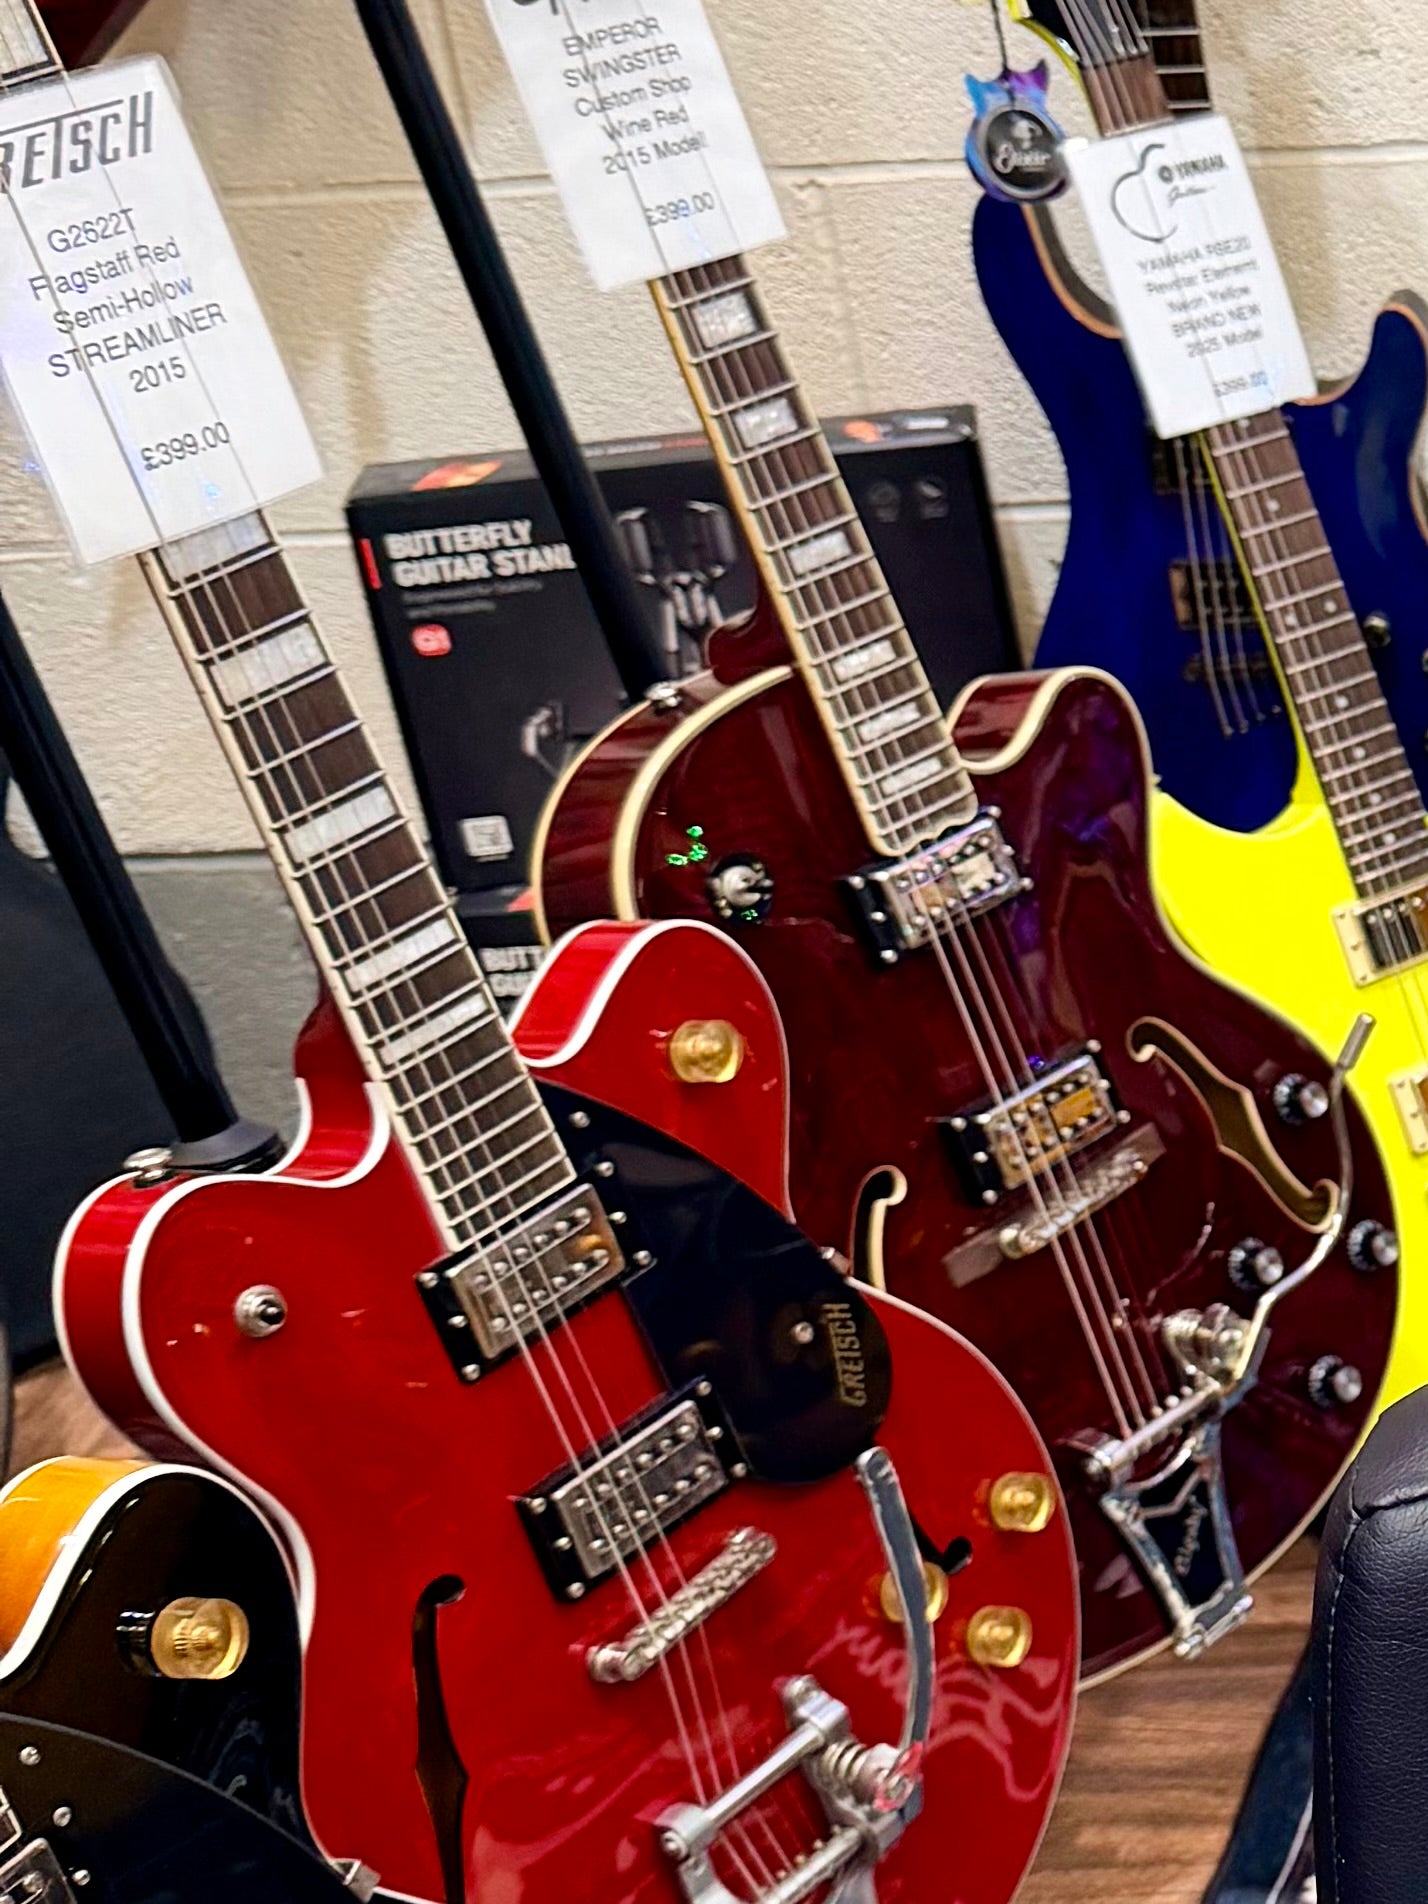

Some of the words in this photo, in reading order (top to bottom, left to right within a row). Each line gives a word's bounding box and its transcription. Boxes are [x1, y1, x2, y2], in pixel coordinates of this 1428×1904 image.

[563, 16, 662, 57] EMPEROR
[563, 44, 682, 88] SWINGSTER
[575, 80, 647, 118] Custom
[650, 75, 691, 102] Shop
[0, 92, 153, 194] RETSCH
[601, 115, 652, 142] Wine
[655, 107, 689, 130] Red
[654, 131, 708, 160] Model
[28, 252, 132, 301] Flagstaff
[136, 236, 181, 272] Red
[55, 276, 194, 335] Semi-Hollow
[49, 303, 228, 379] STREAMLINER
[129, 356, 187, 393] 2015
[141, 421, 231, 472] £399.00
[382, 517, 533, 559] BUTTERFLY
[391, 552, 492, 588] GUITAR
[493, 543, 577, 578] STAN
[821, 1303, 867, 1407] GRETSCH
